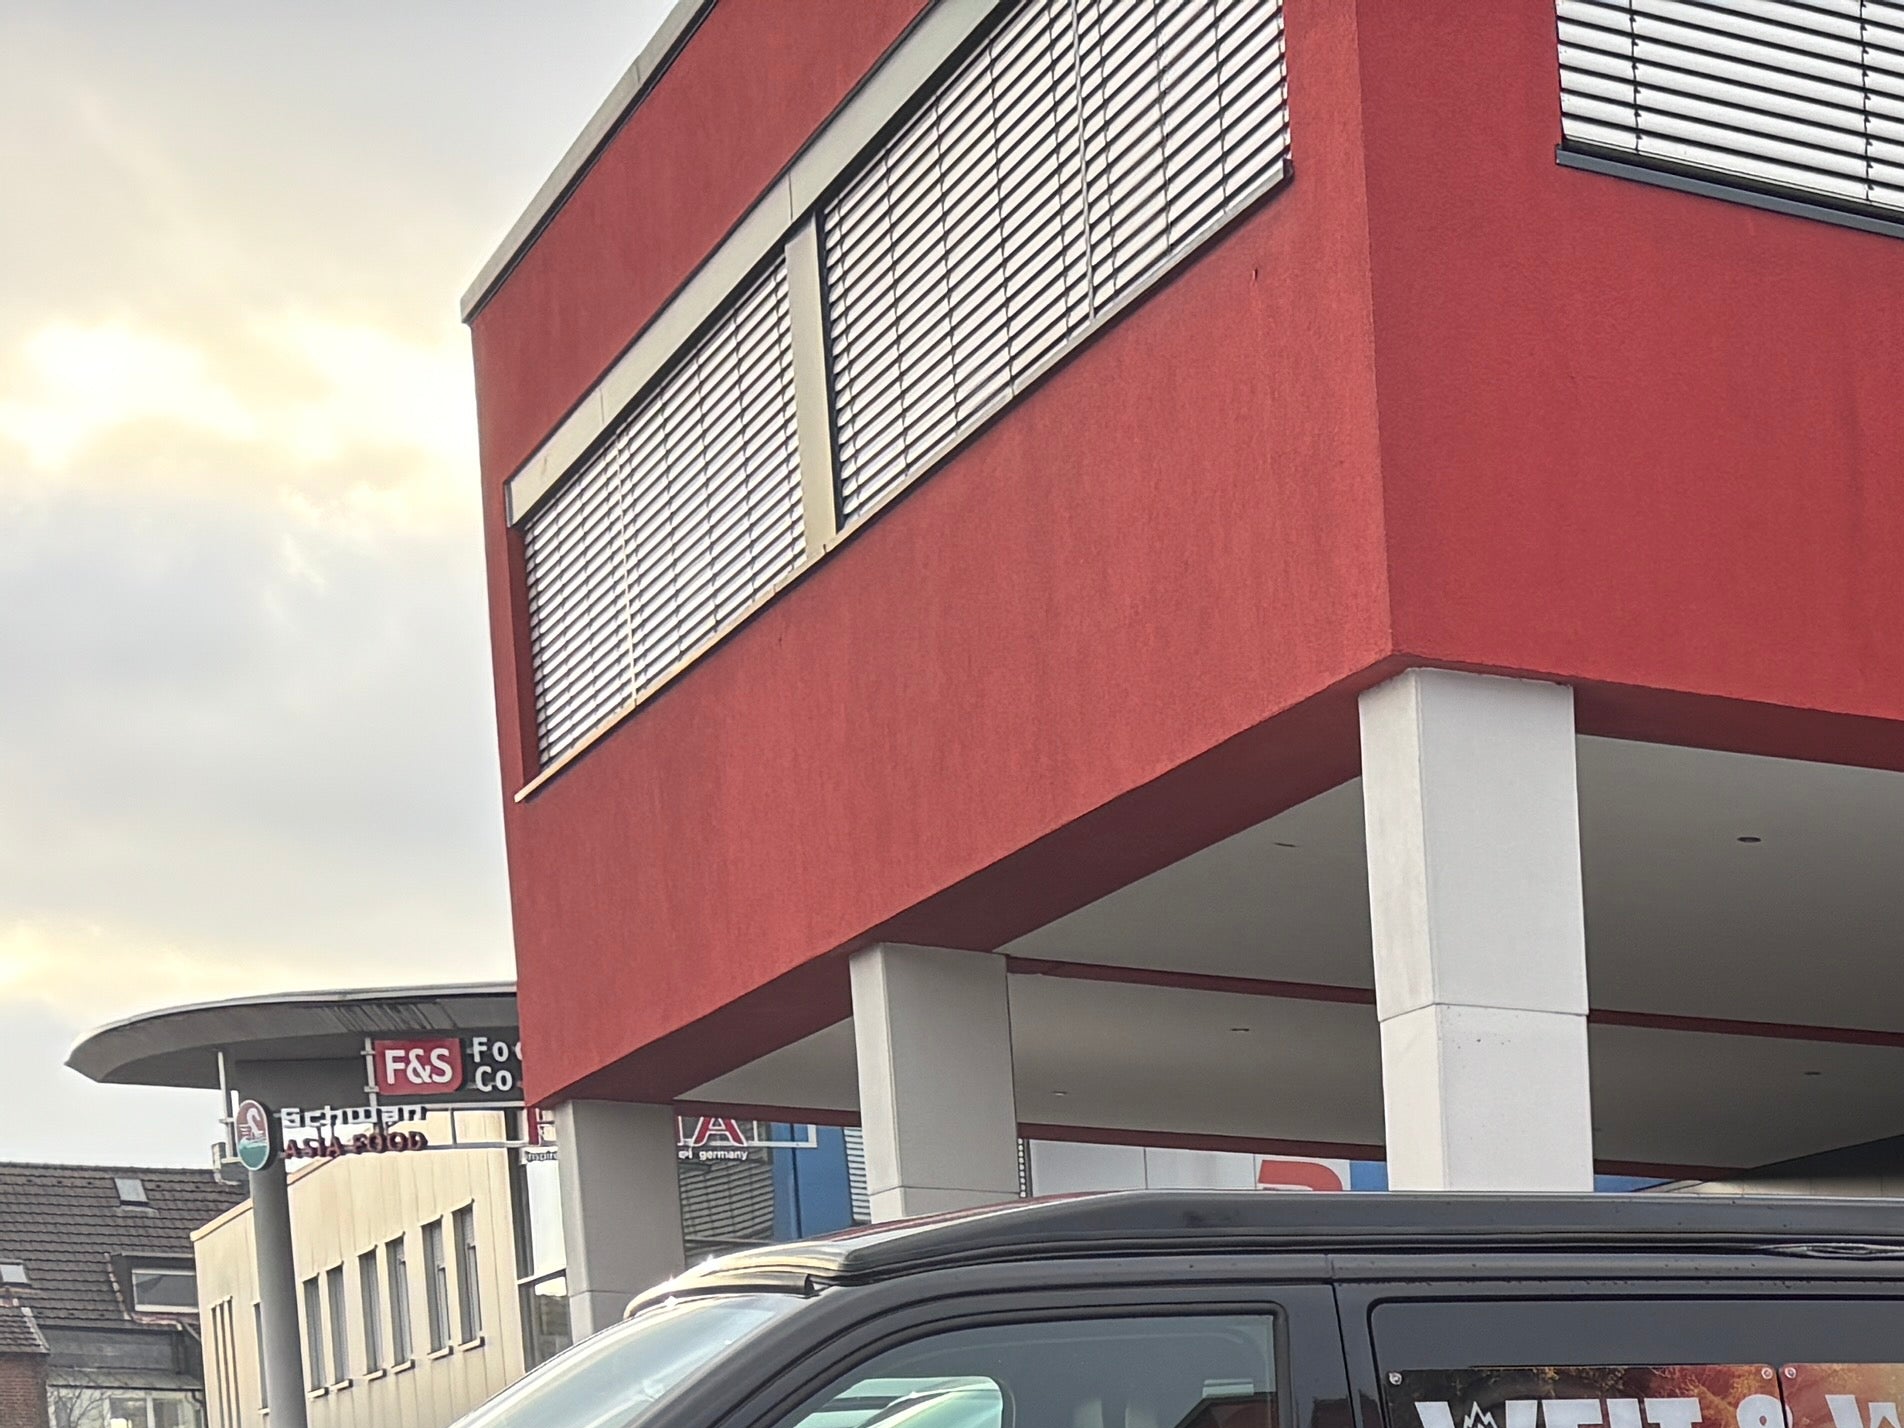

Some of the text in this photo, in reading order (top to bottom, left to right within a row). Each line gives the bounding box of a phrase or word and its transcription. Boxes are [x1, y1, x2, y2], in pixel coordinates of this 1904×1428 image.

[472, 1037, 523, 1063] Fo
[385, 1048, 453, 1085] F&S
[281, 1104, 427, 1128] Schwan
[286, 1131, 428, 1159] ASIA FOOD
[698, 1148, 749, 1161] germany
